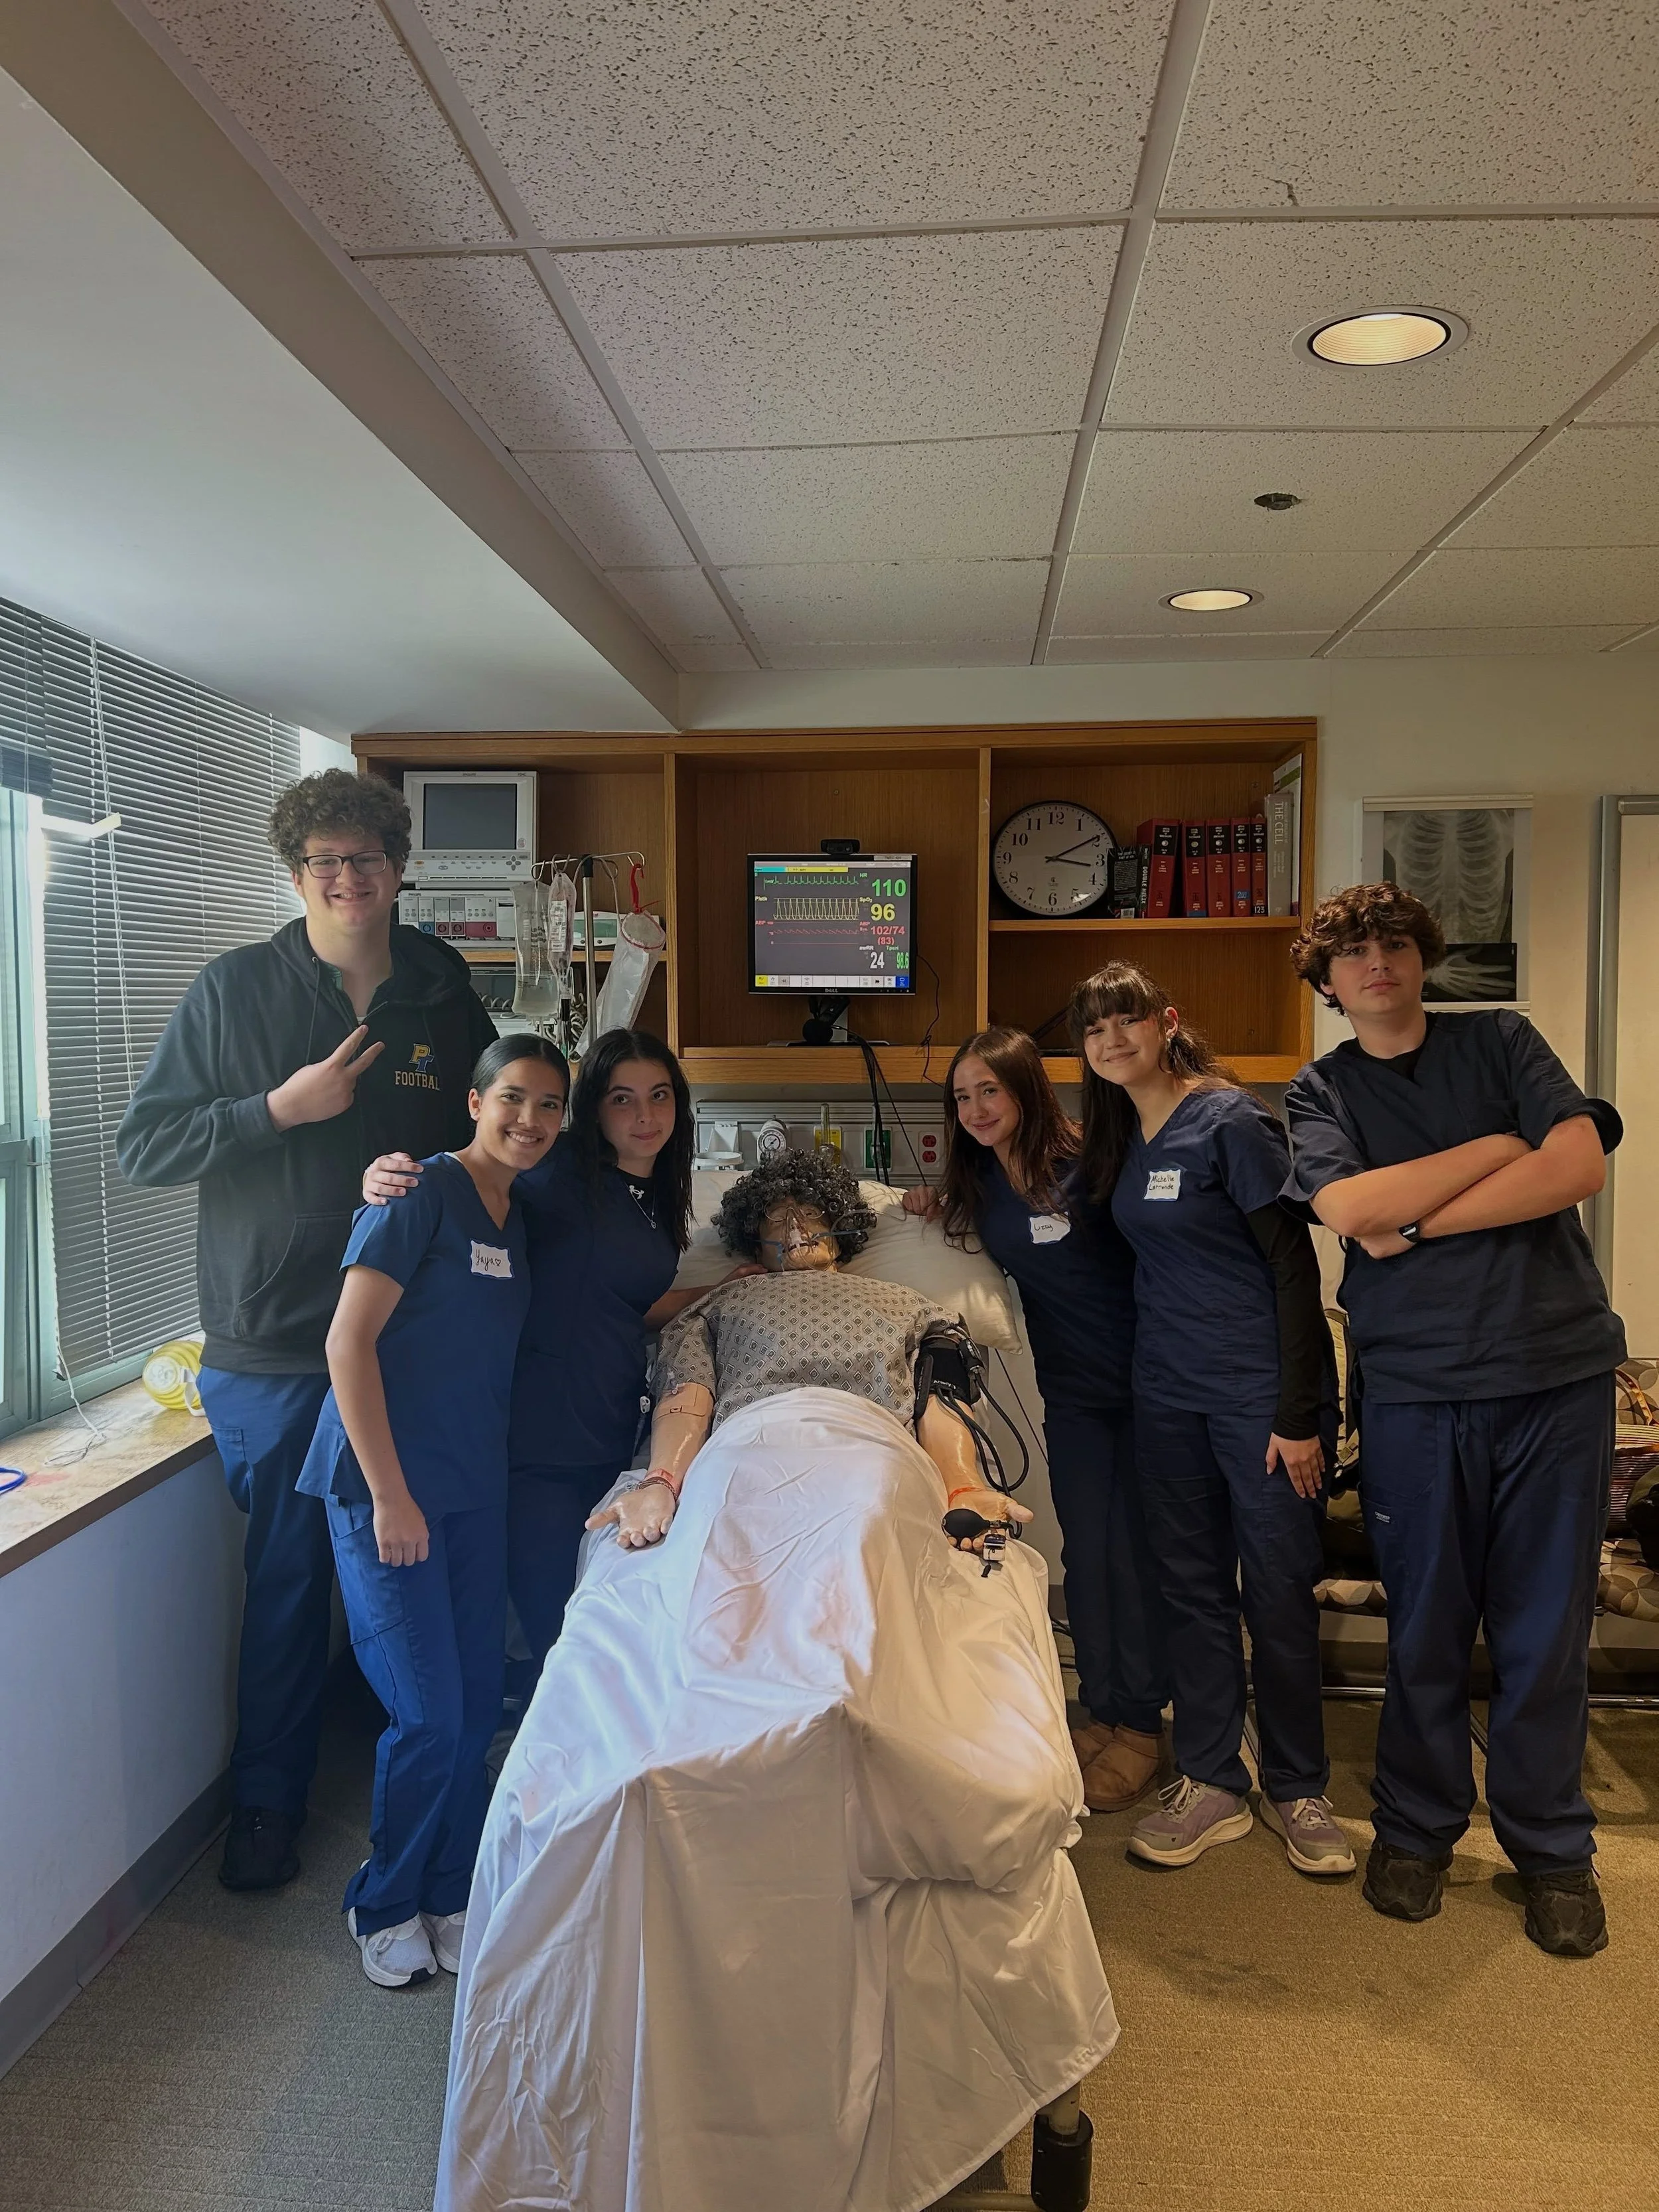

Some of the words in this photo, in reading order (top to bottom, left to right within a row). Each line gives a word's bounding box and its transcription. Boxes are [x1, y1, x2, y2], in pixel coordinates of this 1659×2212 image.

[1275, 801, 1284, 820] THE
[1027, 818, 1041, 830] 11
[1046, 812, 1064, 825] 12
[1076, 818, 1083, 831] 1
[1012, 833, 1029, 846] 10
[1275, 822, 1284, 845] CELL
[1092, 834, 1100, 848] 2
[1003, 851, 1012, 865] 9
[1096, 853, 1105, 866] 3
[1009, 871, 1019, 884] 8
[1088, 873, 1097, 885] 4
[871, 879, 906, 897] 110
[1027, 887, 1035, 900] 7
[1048, 892, 1057, 906] 6
[1070, 889, 1079, 902] 5
[871, 903, 896, 921] 96
[871, 926, 905, 935] 102/74
[877, 936, 895, 946] (83)
[870, 952, 885, 969] 24
[897, 952, 909, 969] 98.6
[1151, 1174, 1175, 1183] Michelle
